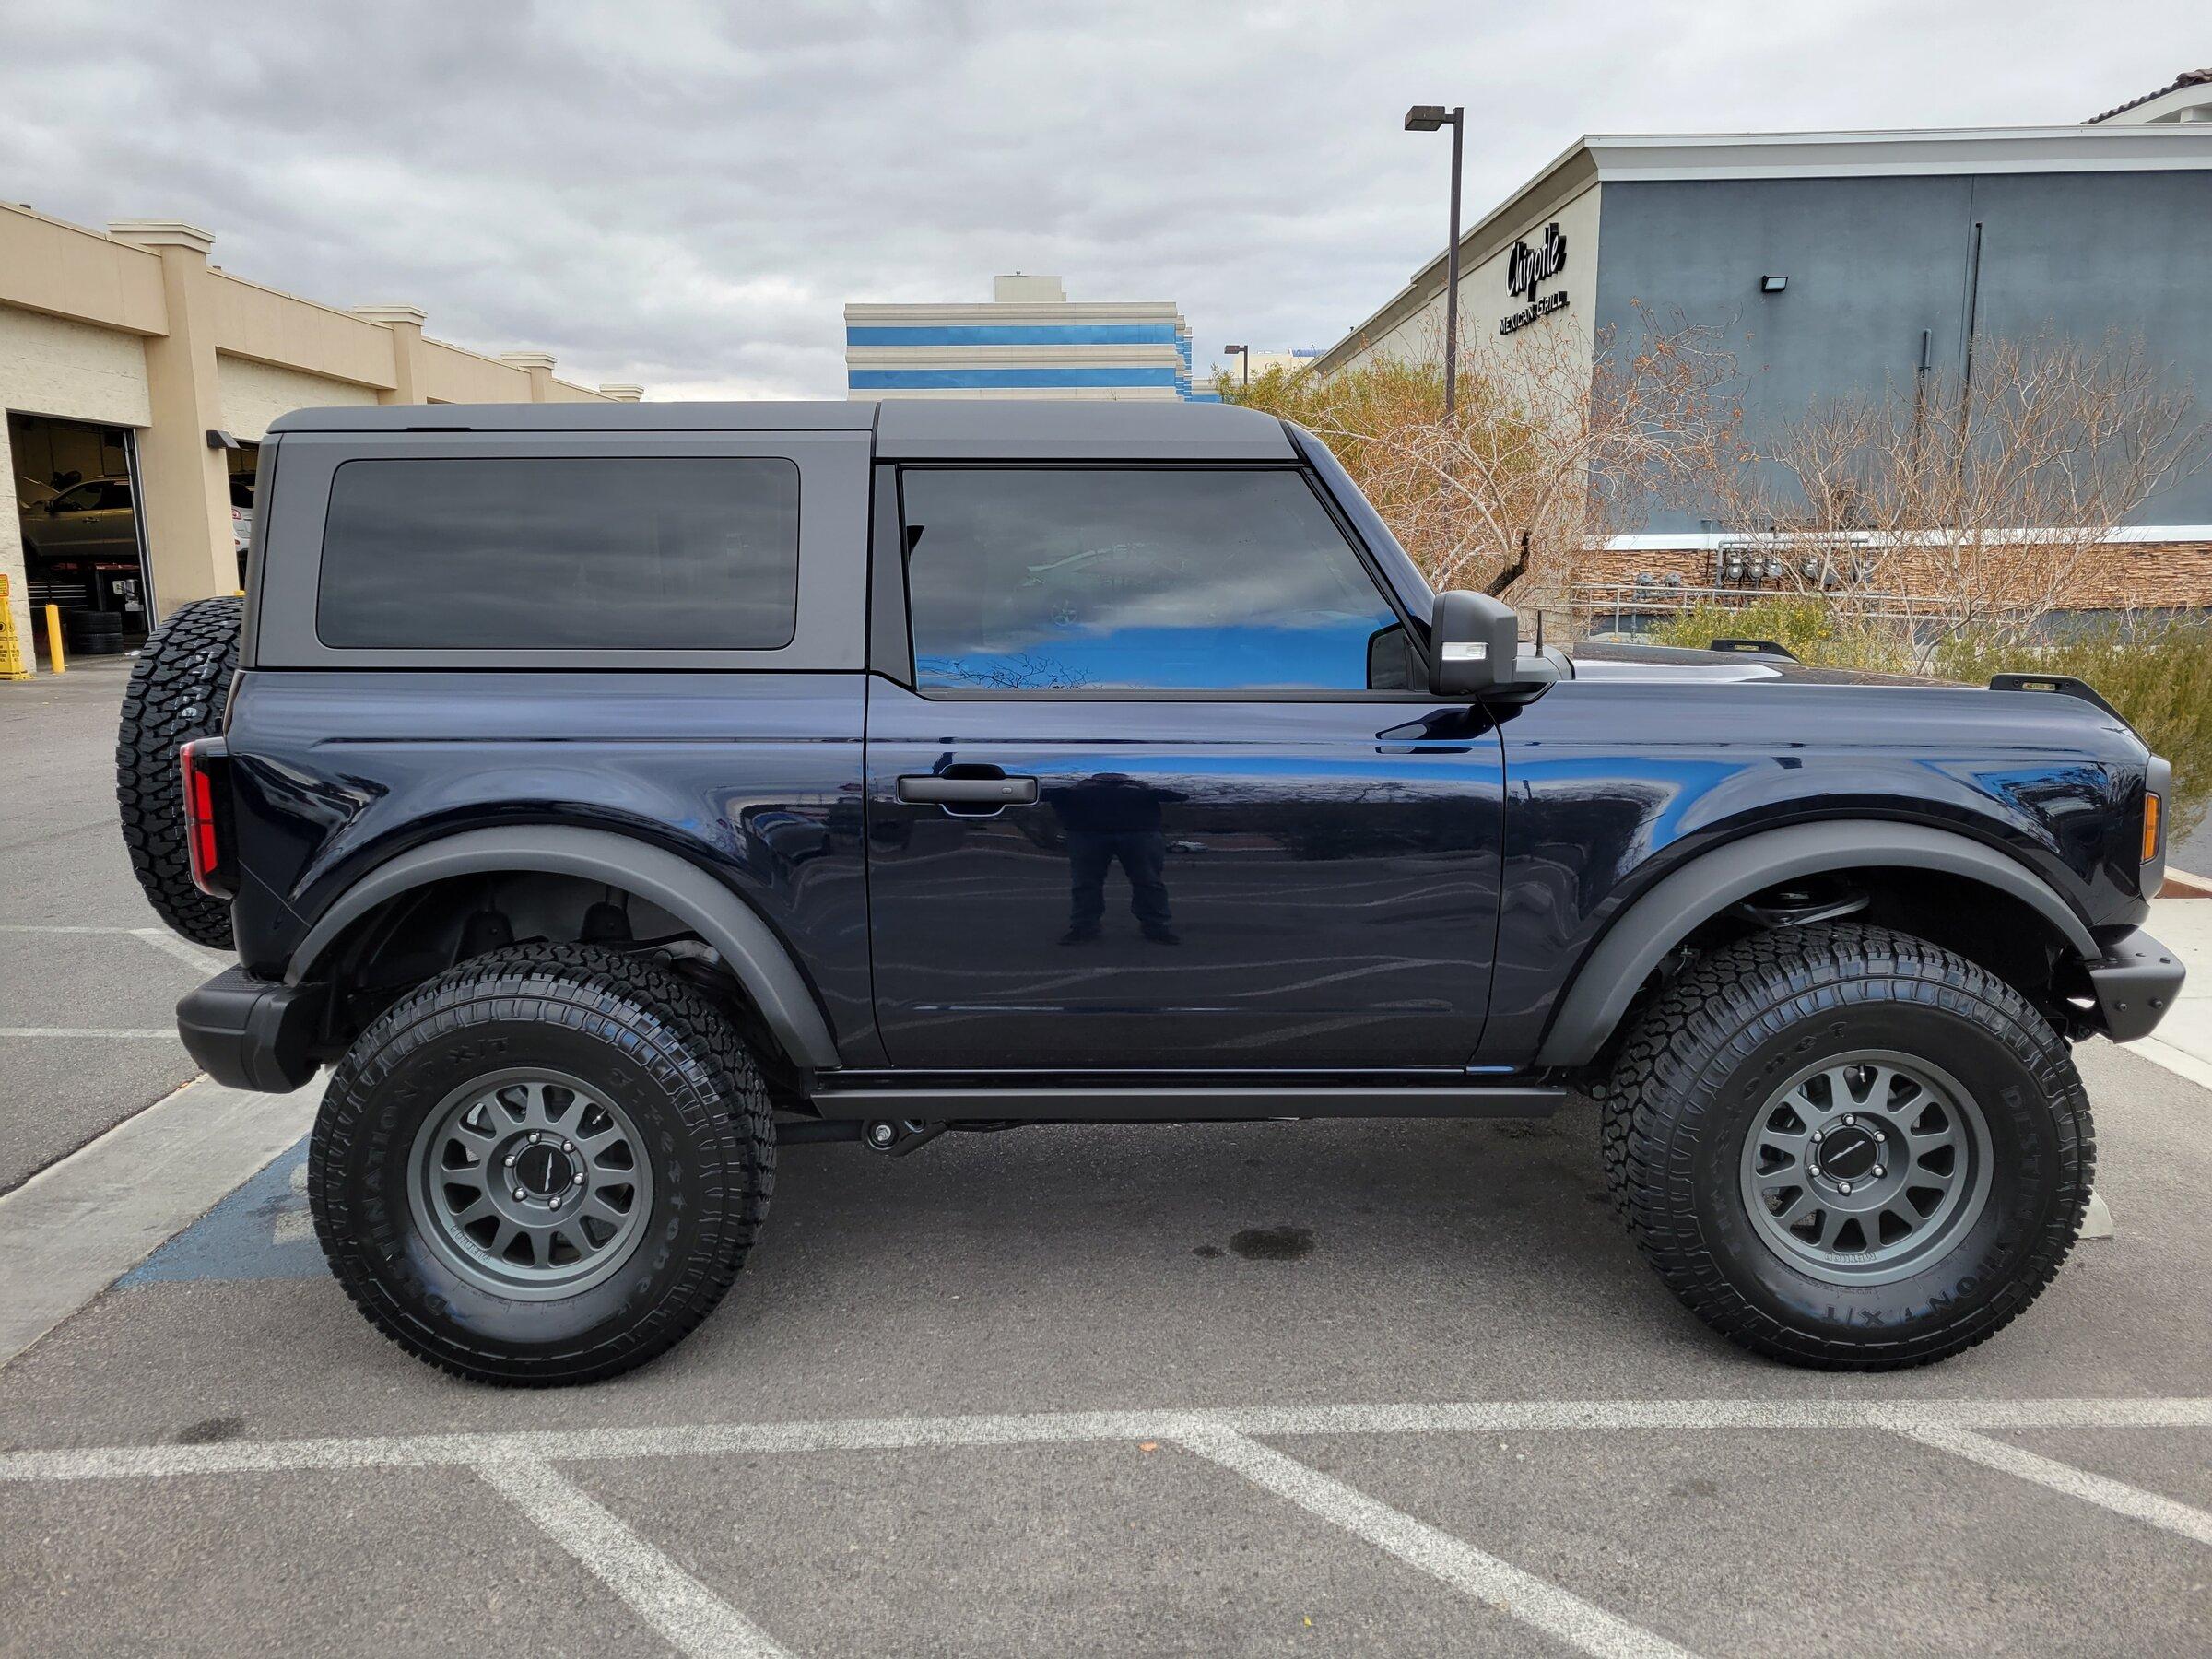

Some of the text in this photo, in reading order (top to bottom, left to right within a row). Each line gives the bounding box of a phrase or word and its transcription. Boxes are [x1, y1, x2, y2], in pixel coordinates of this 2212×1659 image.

[1506, 222, 1567, 302] Chipotle
[1500, 290, 1570, 335] MEXICAN GRILL
